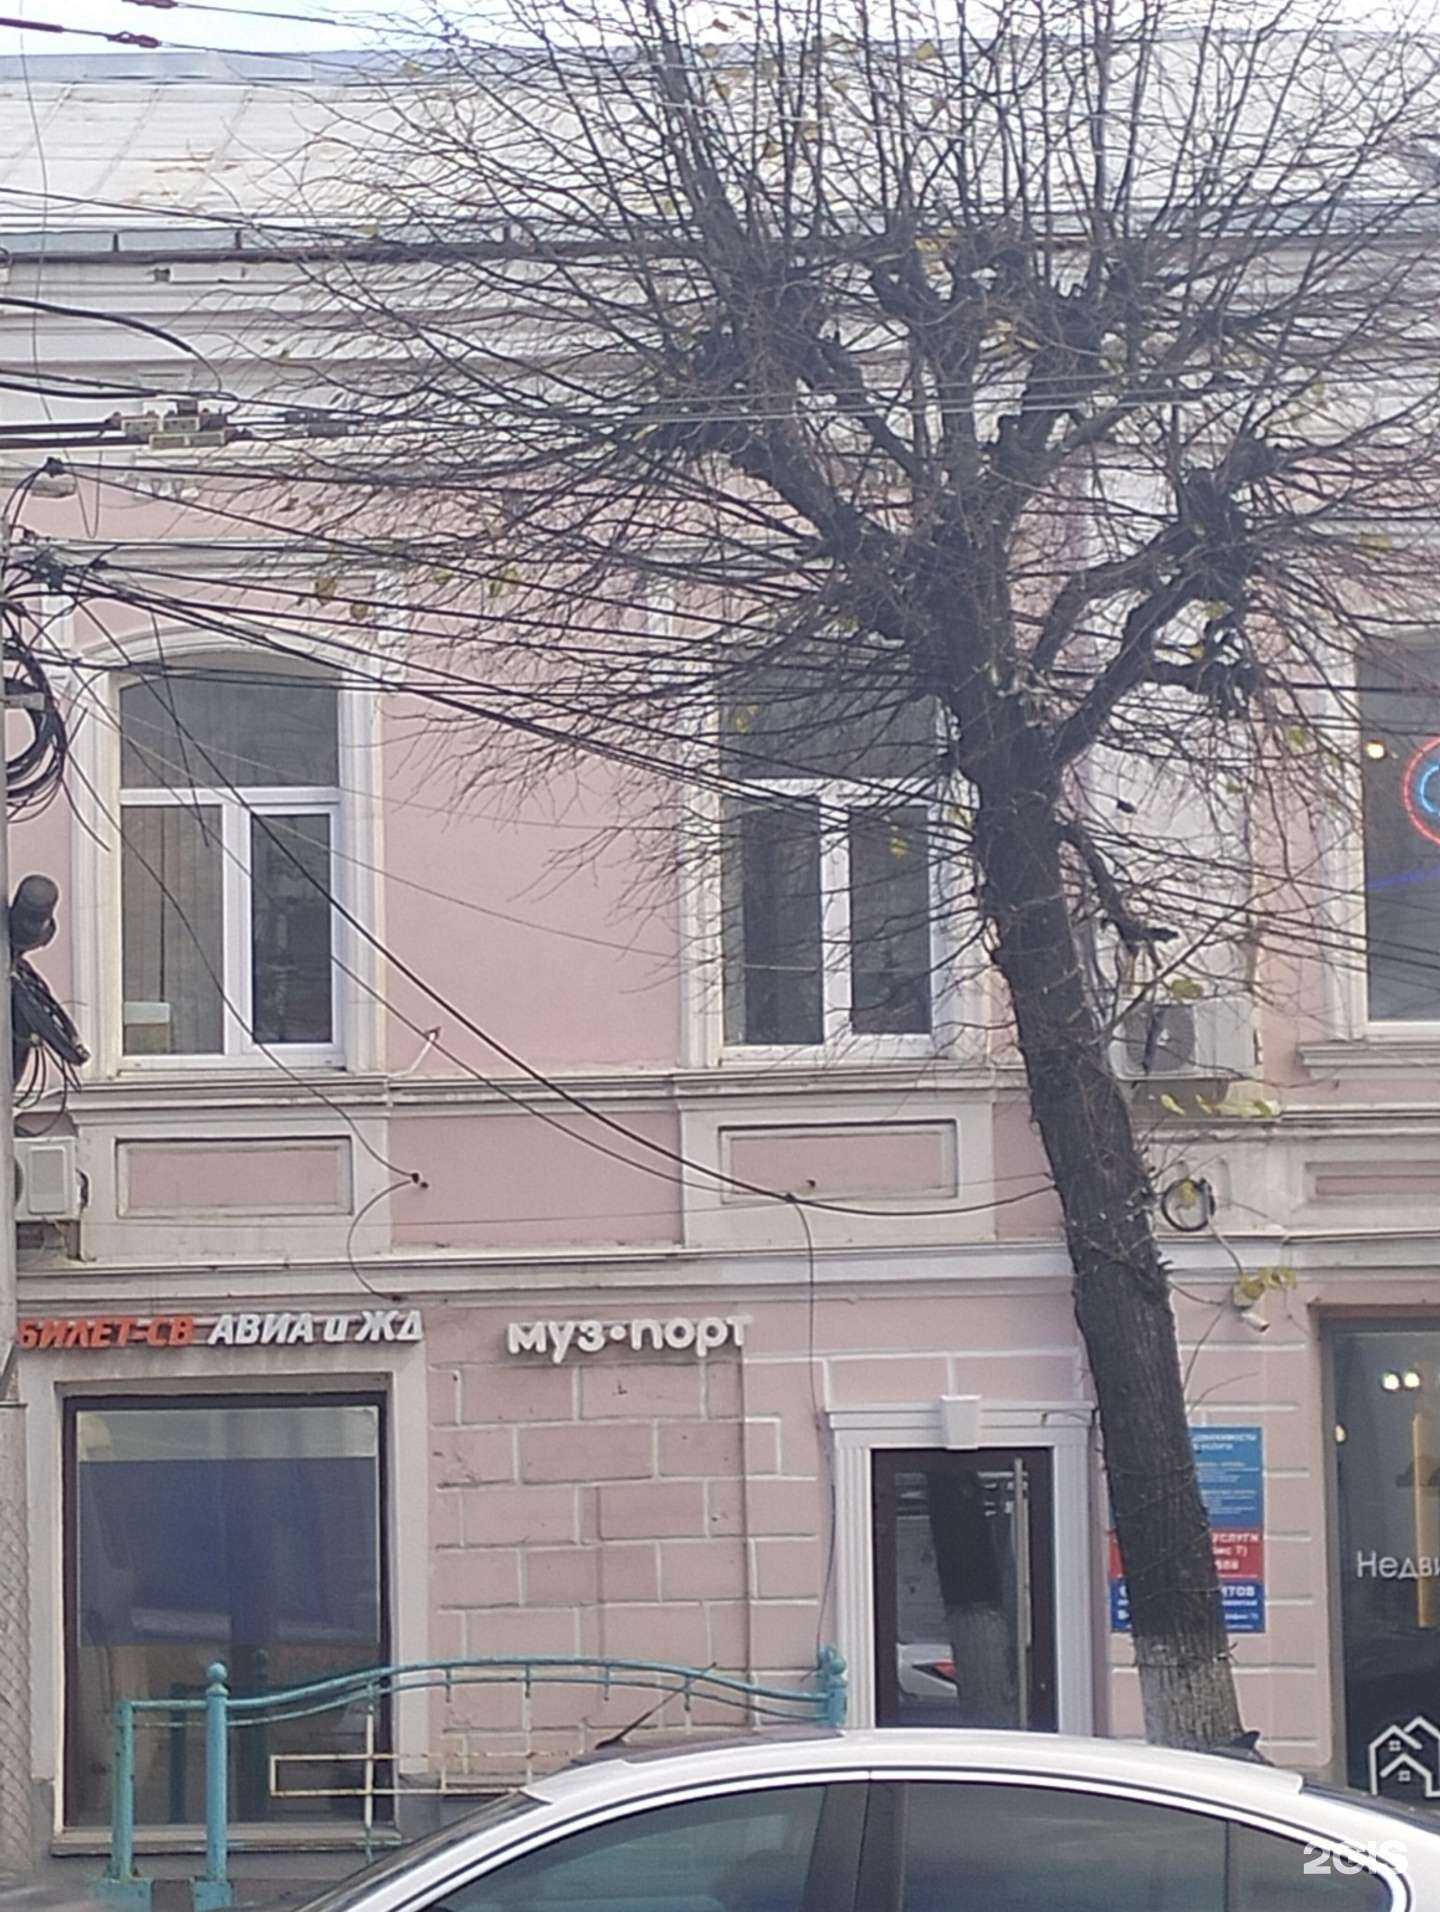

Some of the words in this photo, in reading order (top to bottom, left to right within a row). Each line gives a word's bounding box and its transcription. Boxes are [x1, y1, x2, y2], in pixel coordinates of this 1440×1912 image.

[17, 1315, 197, 1349] БИЛЕТ-СВ
[207, 1313, 315, 1347] АВИА
[354, 1309, 425, 1343] ЖД
